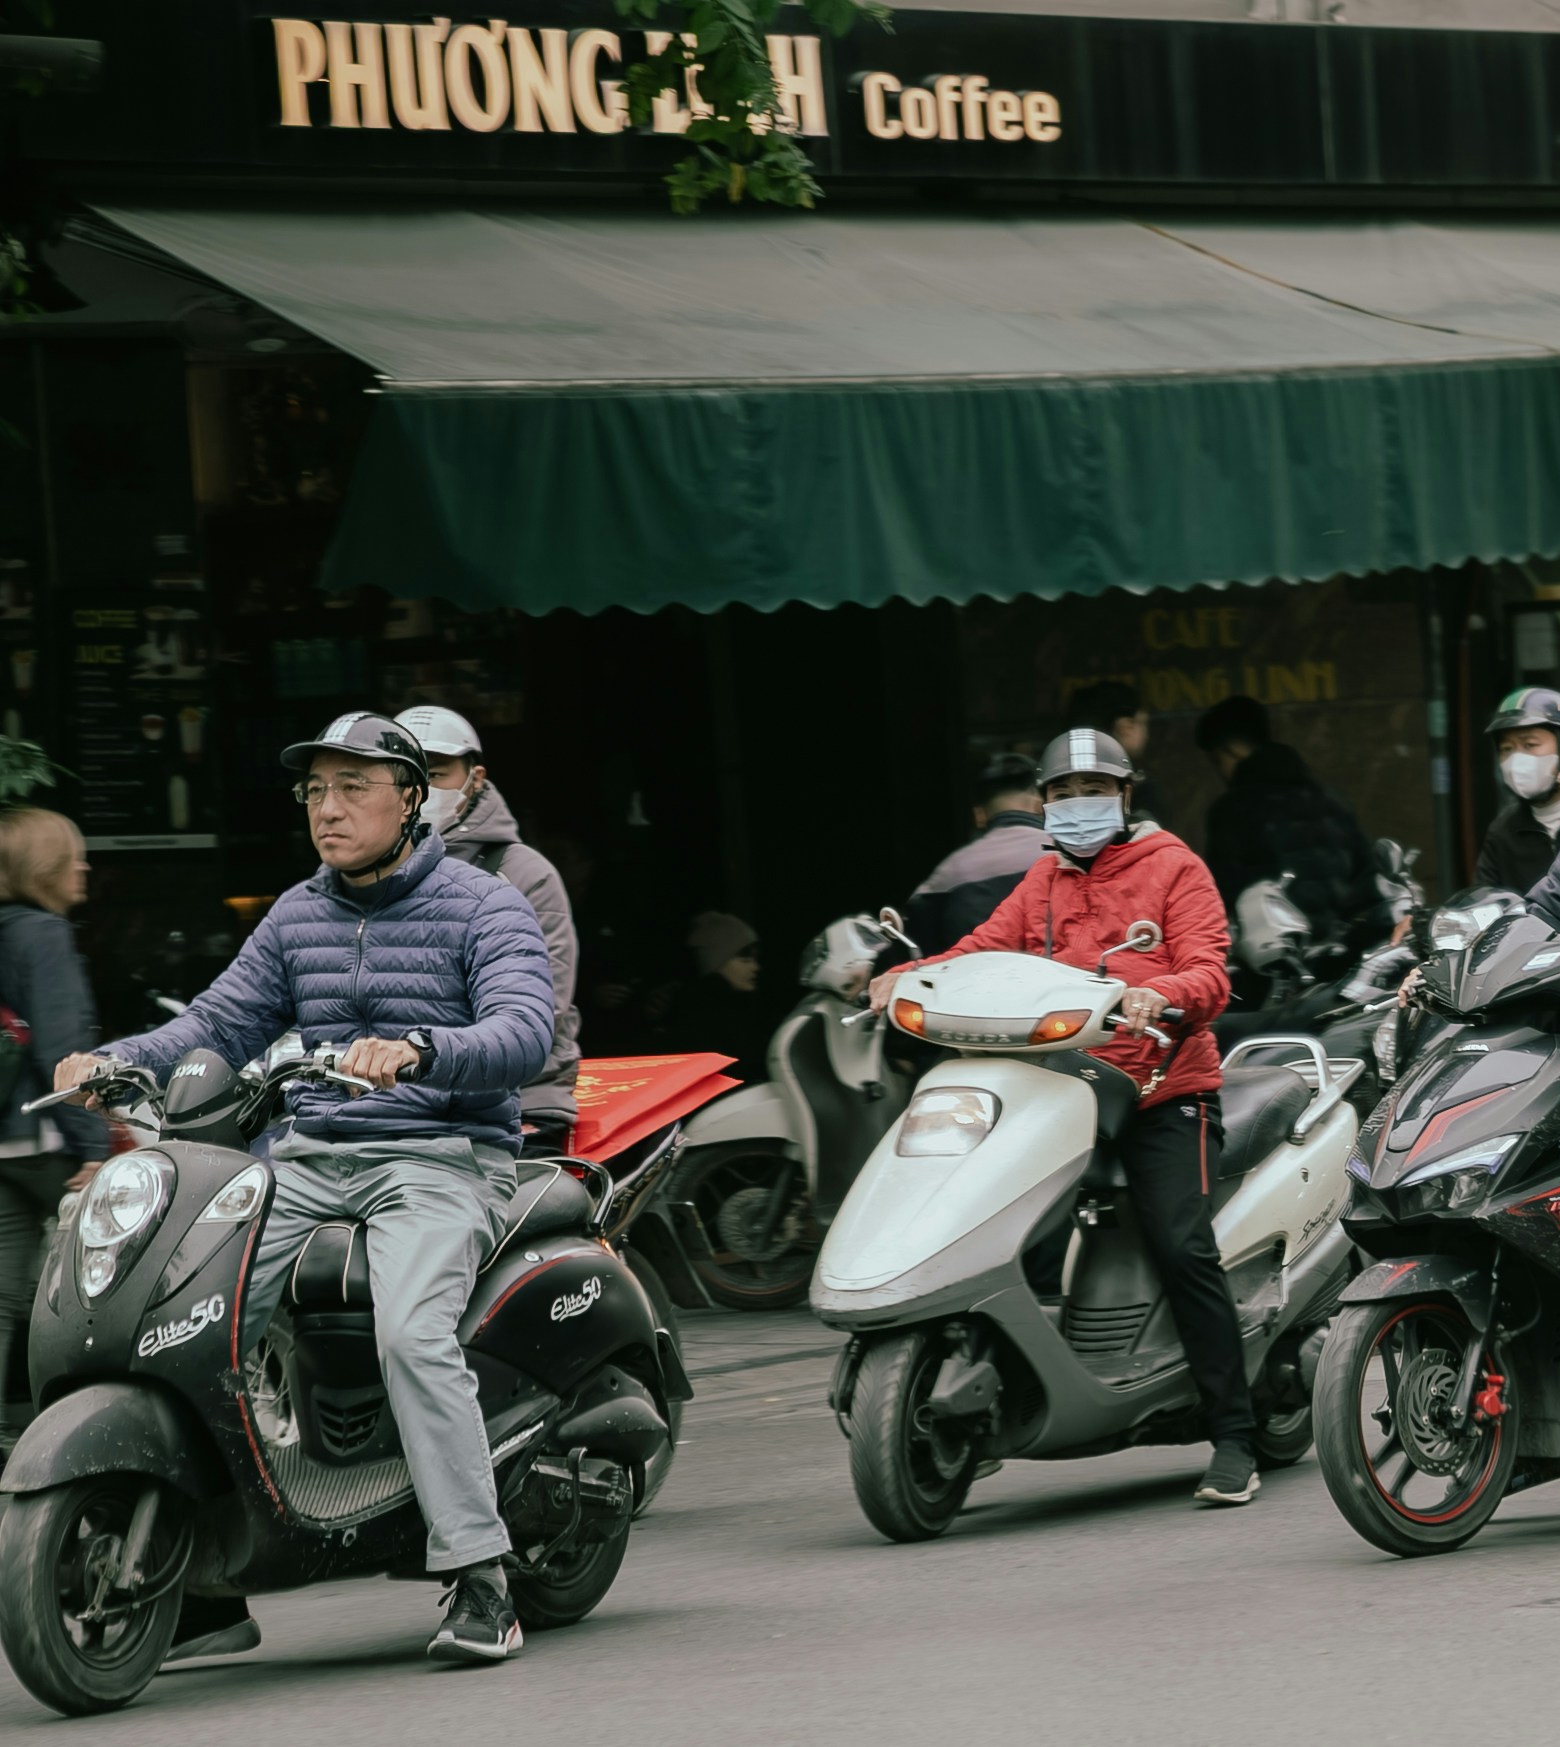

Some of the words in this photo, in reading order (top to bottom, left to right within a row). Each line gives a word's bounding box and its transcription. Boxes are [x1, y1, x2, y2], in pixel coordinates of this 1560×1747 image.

[271, 17, 631, 134] PHƯƠNG
[862, 71, 1062, 142] Coffee
[1140, 608, 1244, 650] CAFE
